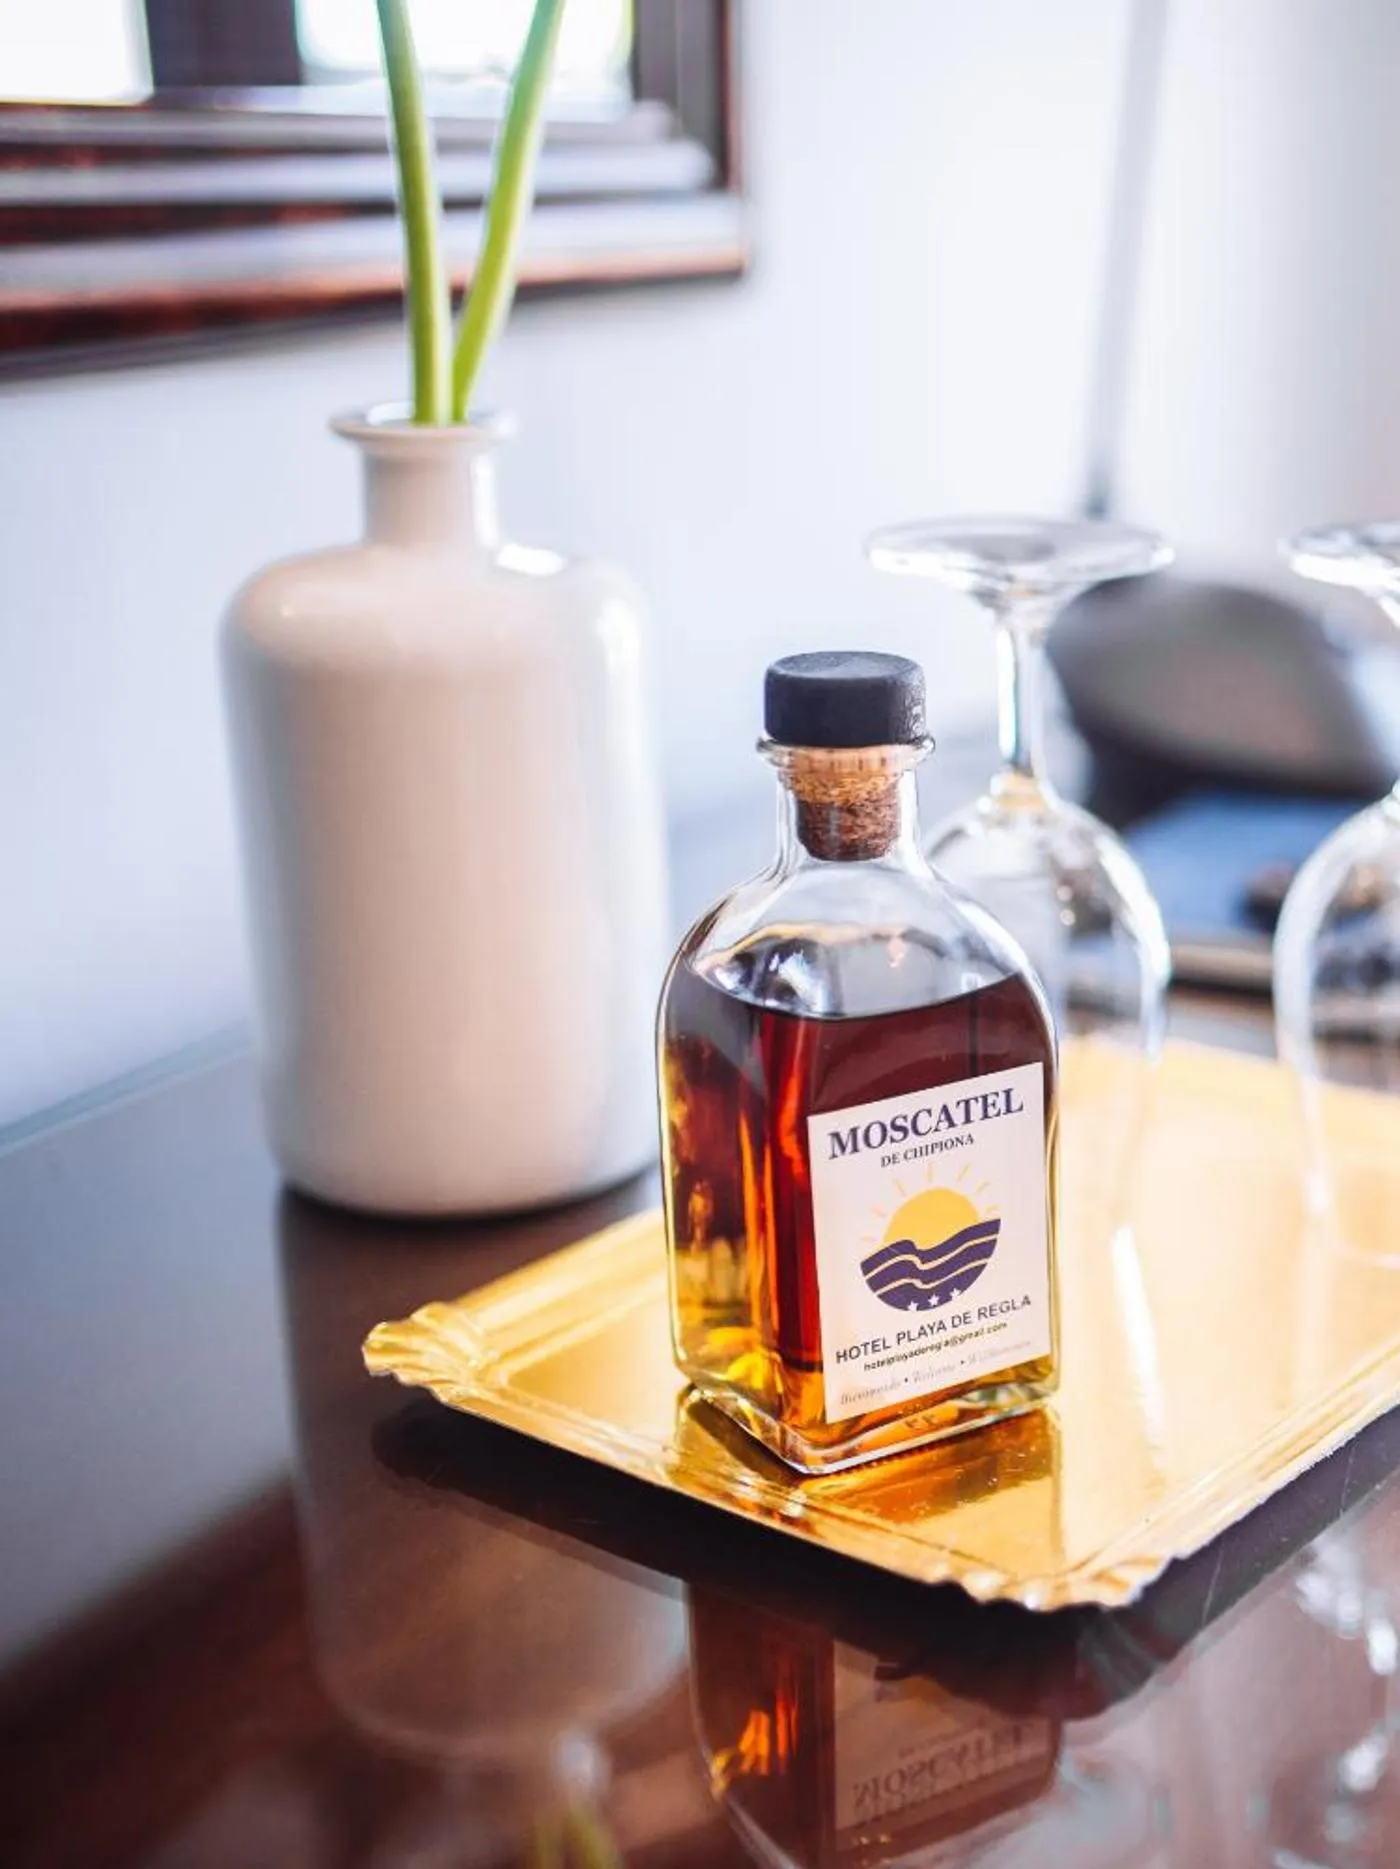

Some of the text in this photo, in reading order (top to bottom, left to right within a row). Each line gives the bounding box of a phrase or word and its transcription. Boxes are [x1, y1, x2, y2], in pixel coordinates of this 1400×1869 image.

[828, 1088, 1024, 1160] MOSCATEL
[880, 1133, 975, 1168] DE CHIPIONA
[836, 1294, 1031, 1364] HOTEL PLAYA DE REGLA
